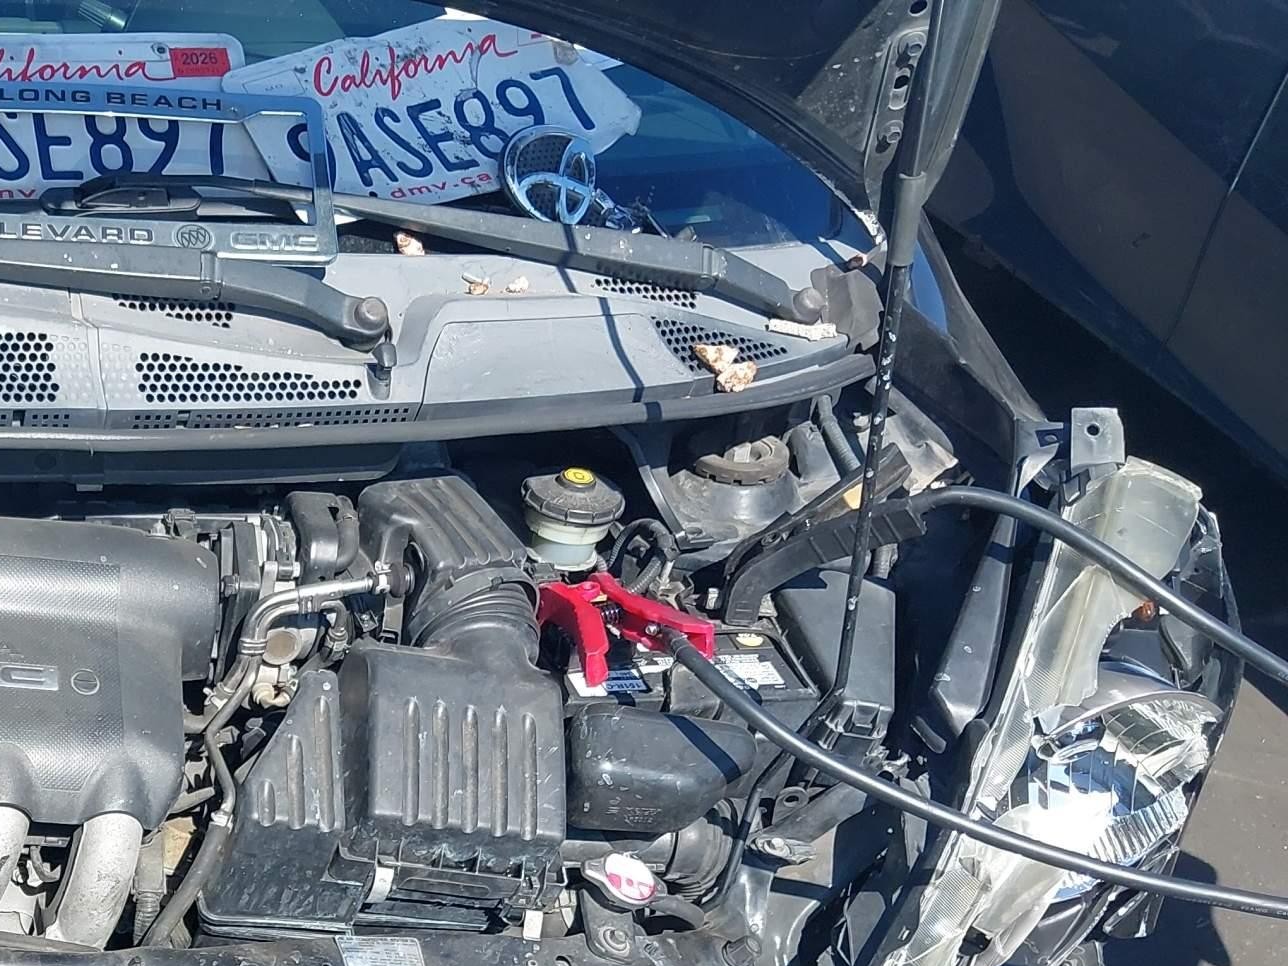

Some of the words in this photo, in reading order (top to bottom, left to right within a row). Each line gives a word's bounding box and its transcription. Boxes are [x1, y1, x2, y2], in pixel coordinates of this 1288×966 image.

[182, 52, 218, 65] 2026
[314, 27, 518, 101] California
[0, 87, 91, 103] LONG
[106, 91, 222, 111] BEACH
[231, 231, 319, 251] GMC
